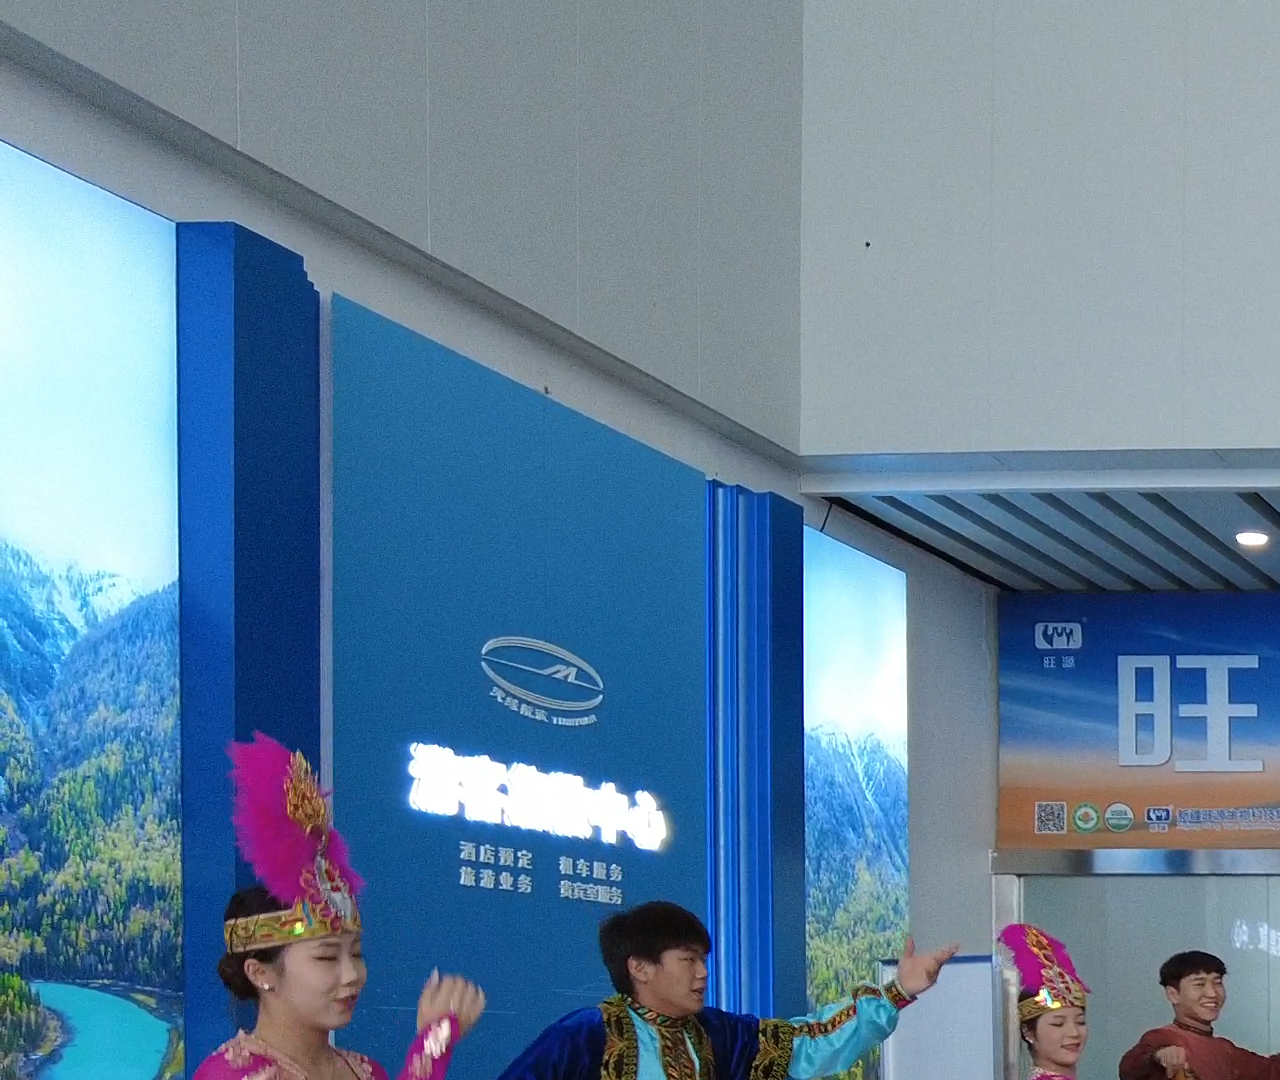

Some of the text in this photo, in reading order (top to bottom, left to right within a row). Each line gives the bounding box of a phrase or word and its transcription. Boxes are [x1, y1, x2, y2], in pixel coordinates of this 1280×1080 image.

[459, 841, 622, 881] 酒店预定 租车服务
[459, 866, 533, 893] 旅游业务
